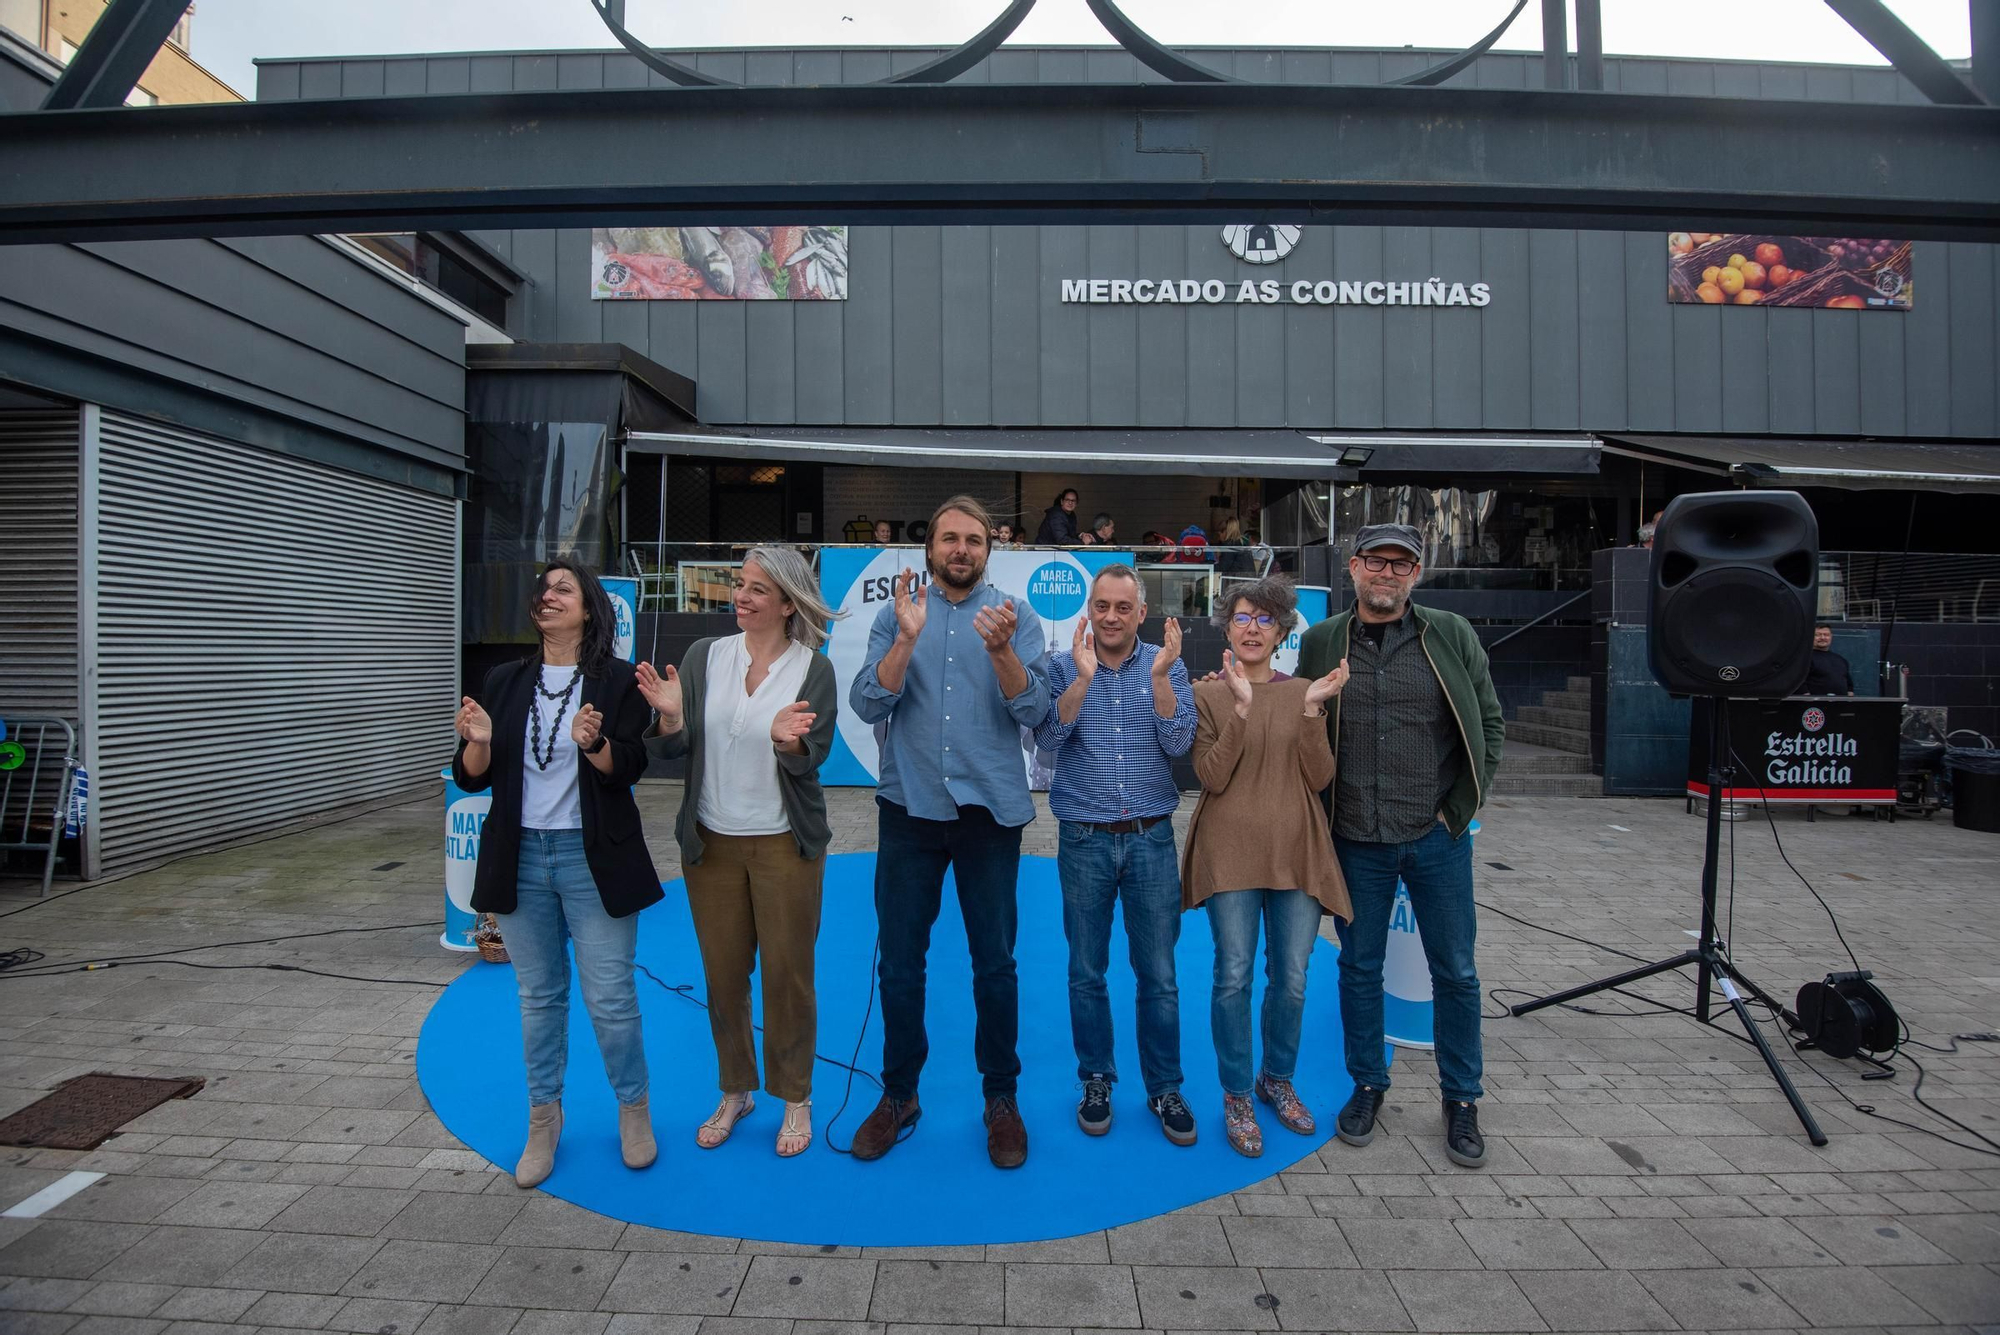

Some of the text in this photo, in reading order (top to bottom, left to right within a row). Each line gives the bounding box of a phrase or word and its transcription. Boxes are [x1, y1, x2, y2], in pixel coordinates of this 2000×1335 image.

[1061, 277, 1492, 307] MERCADO AS CONCHIÑAS
[1040, 569, 1074, 582] MAREA
[1032, 581, 1082, 596] ATLÁNTICA
[1764, 731, 1858, 757] Estrella
[1767, 758, 1852, 784] Galicia
[453, 812, 488, 835] MAR
